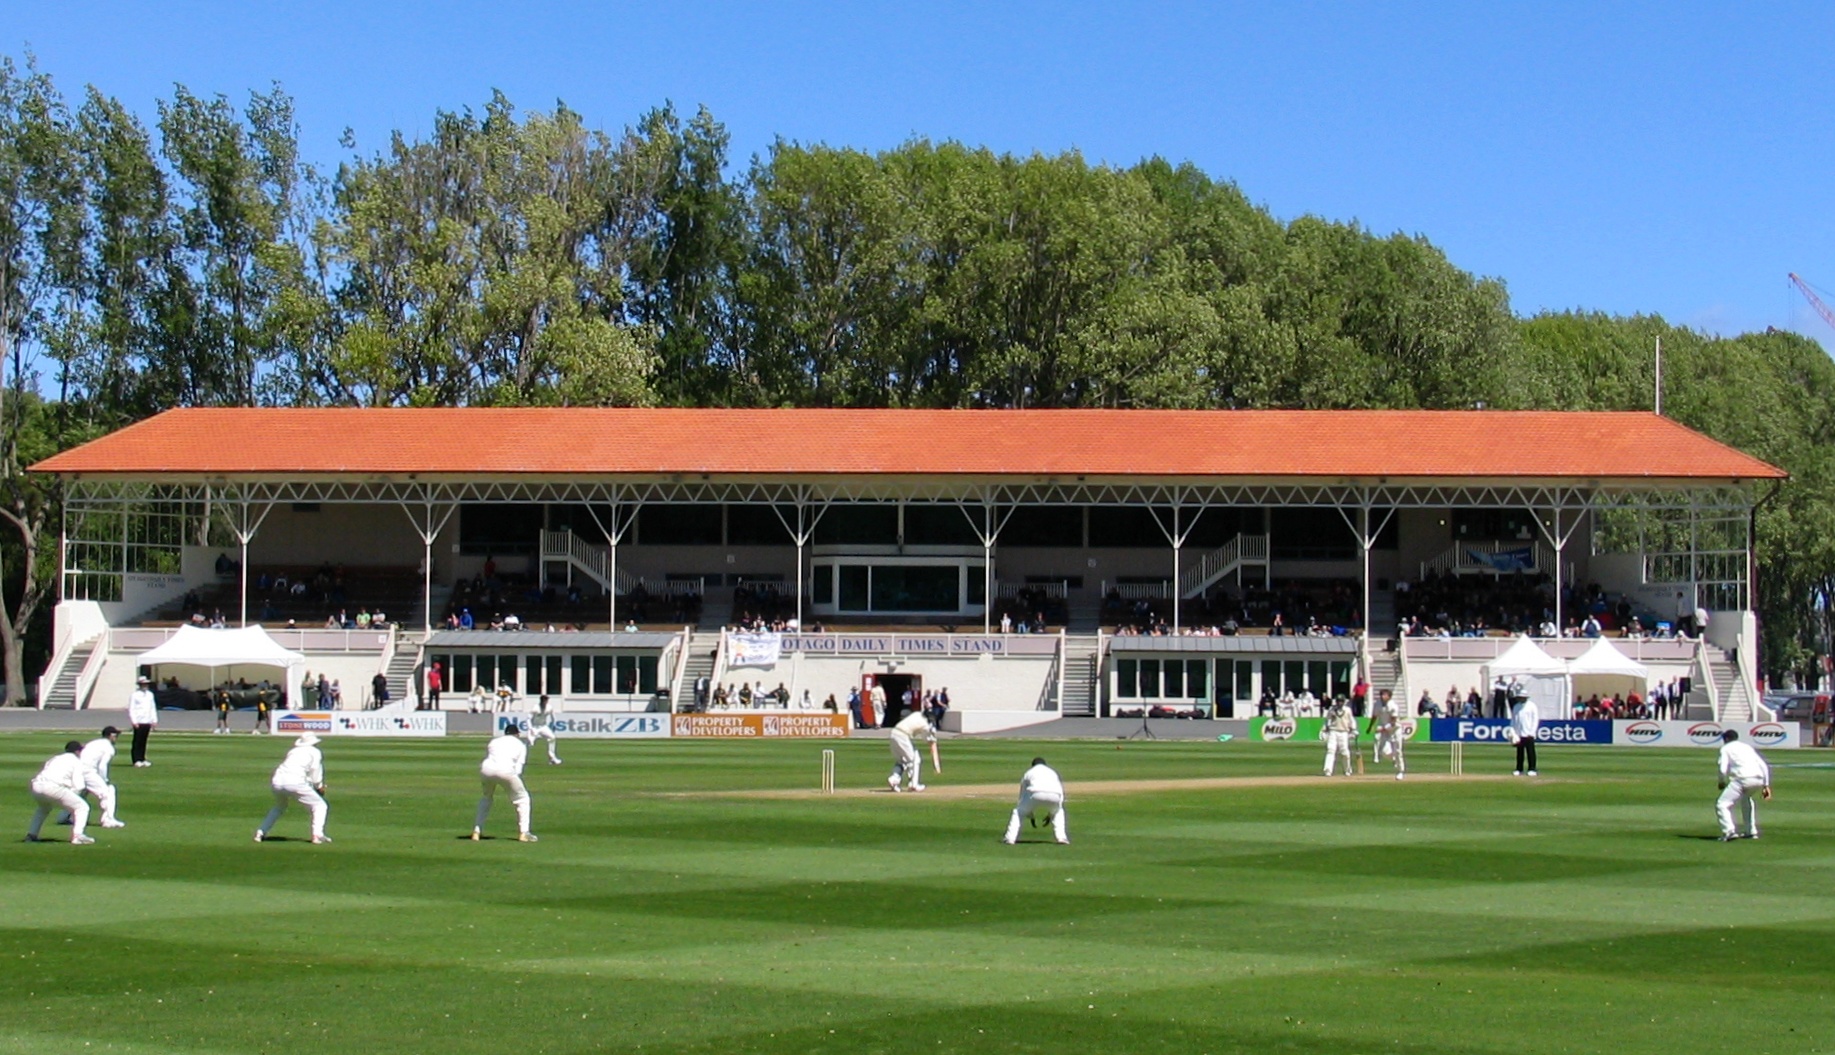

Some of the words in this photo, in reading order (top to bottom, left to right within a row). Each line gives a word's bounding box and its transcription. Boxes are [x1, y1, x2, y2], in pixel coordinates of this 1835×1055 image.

[781, 639, 836, 651] OTAGO
[842, 639, 887, 651] DAILY
[898, 639, 945, 651] TIMES
[953, 639, 1002, 651] STAND
[355, 717, 389, 730] WHK
[409, 717, 444, 731] WHK
[498, 716, 612, 732] Nestalk
[614, 717, 660, 733] ZB
[692, 716, 745, 726] PROPERTY
[780, 716, 833, 726] PROPERTY
[692, 726, 756, 736] DEVELOPERS
[780, 726, 844, 736] DEVELOPERS
[1264, 725, 1293, 735] MILO
